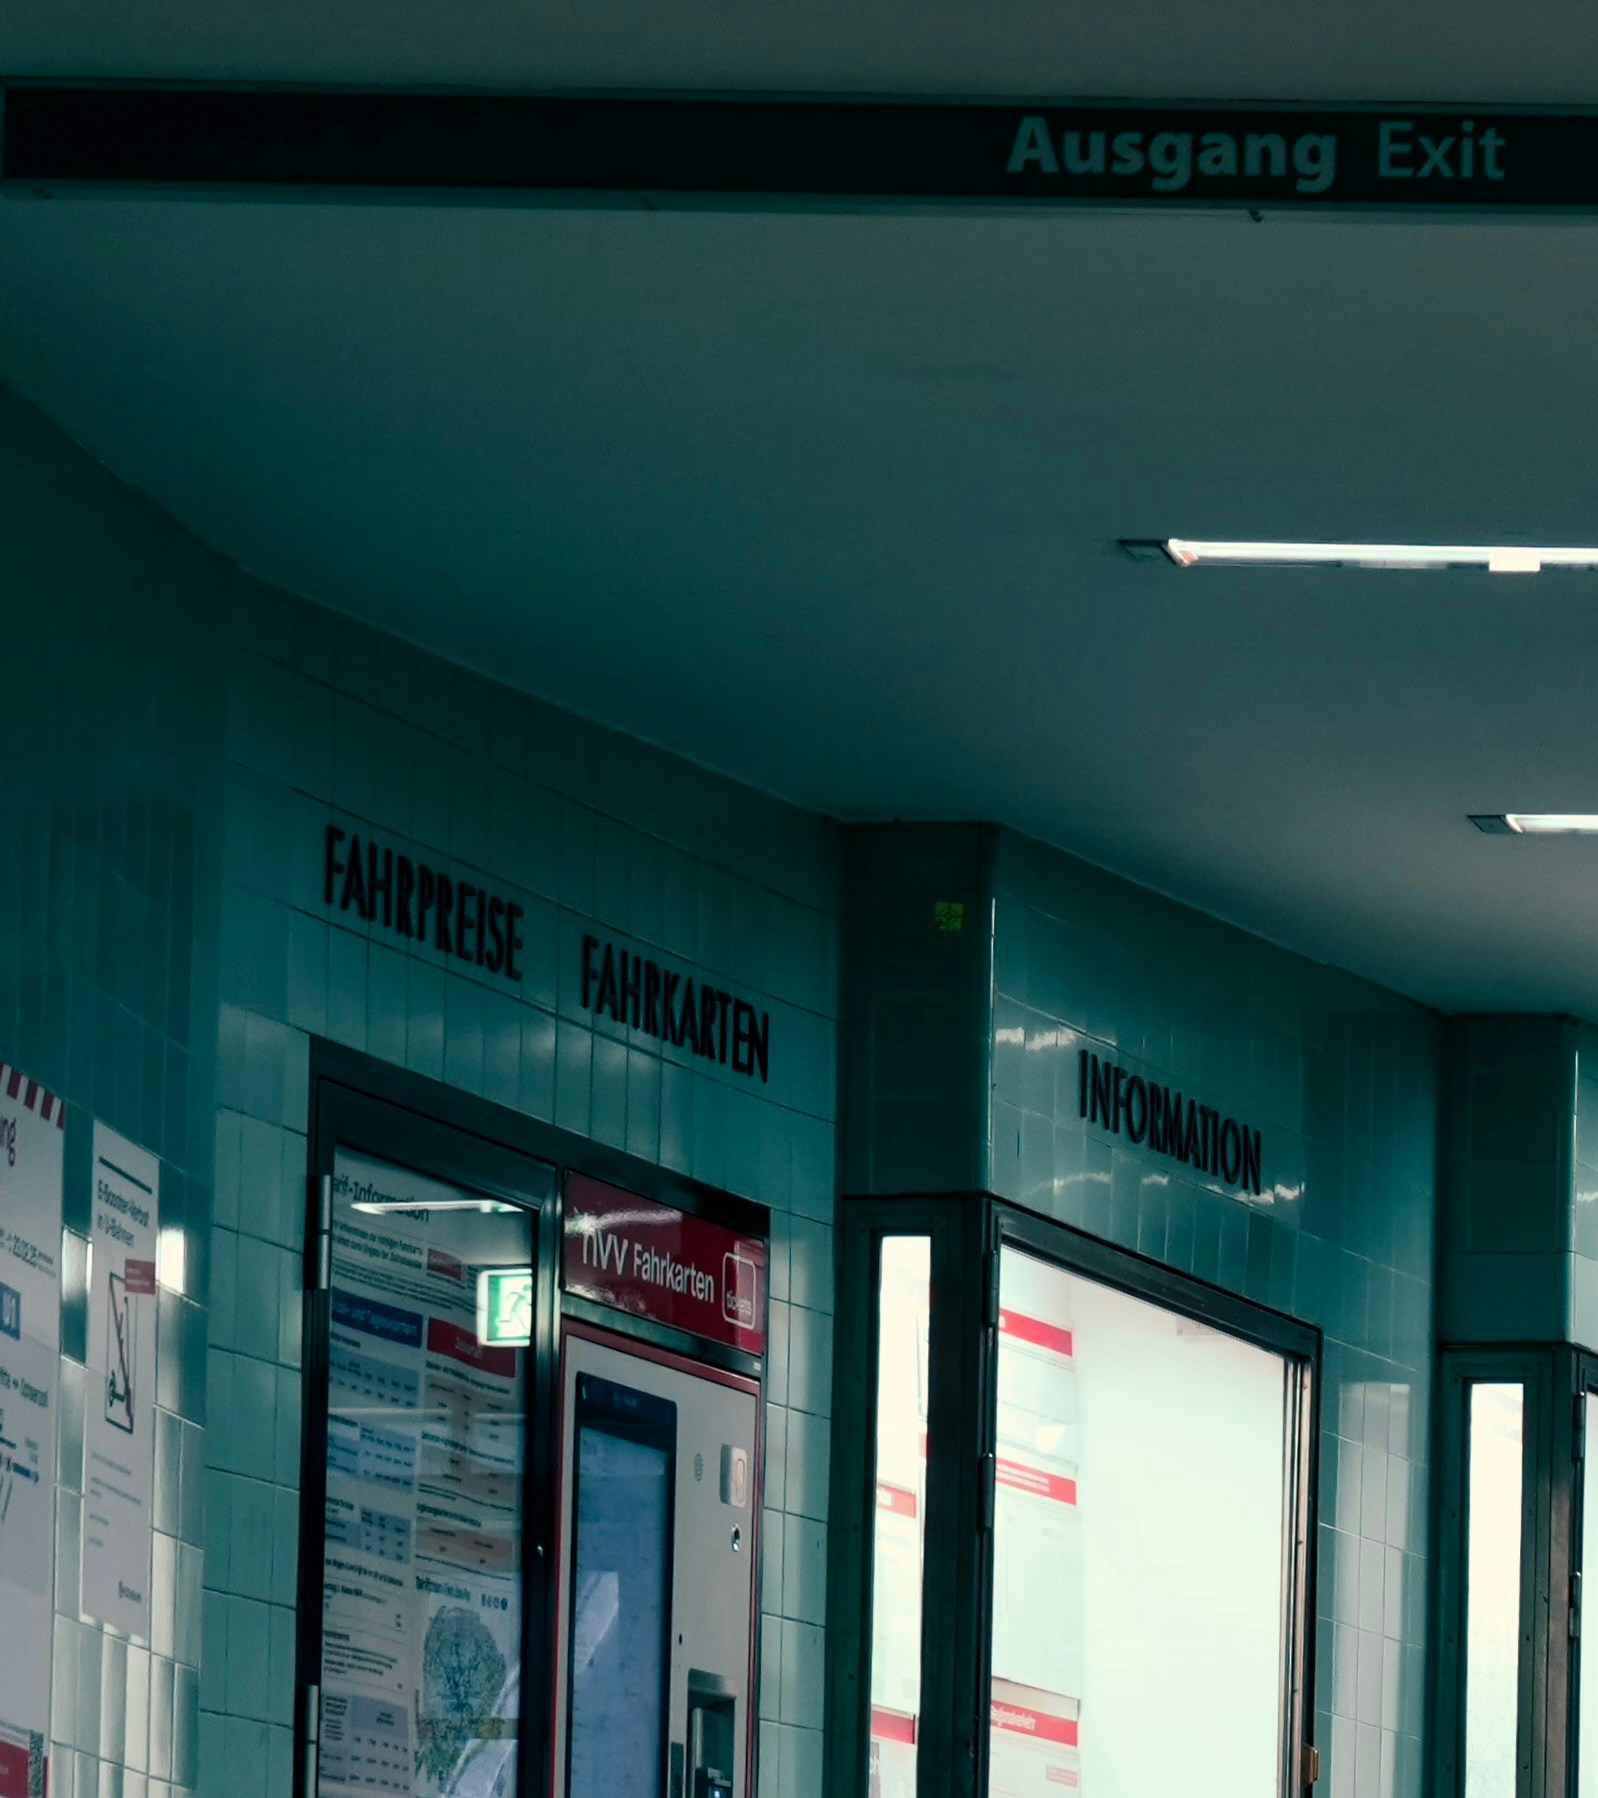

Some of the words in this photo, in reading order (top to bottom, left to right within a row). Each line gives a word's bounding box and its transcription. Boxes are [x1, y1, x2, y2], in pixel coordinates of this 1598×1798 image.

[1006, 115, 1337, 192] Ausgang
[1378, 120, 1506, 179] Exit
[325, 824, 524, 982] FAHRPREISE
[581, 933, 769, 1084] FAHRKARTEN
[1079, 1049, 1262, 1196] INFORMATION
[632, 1242, 715, 1304] Fahrkarten
